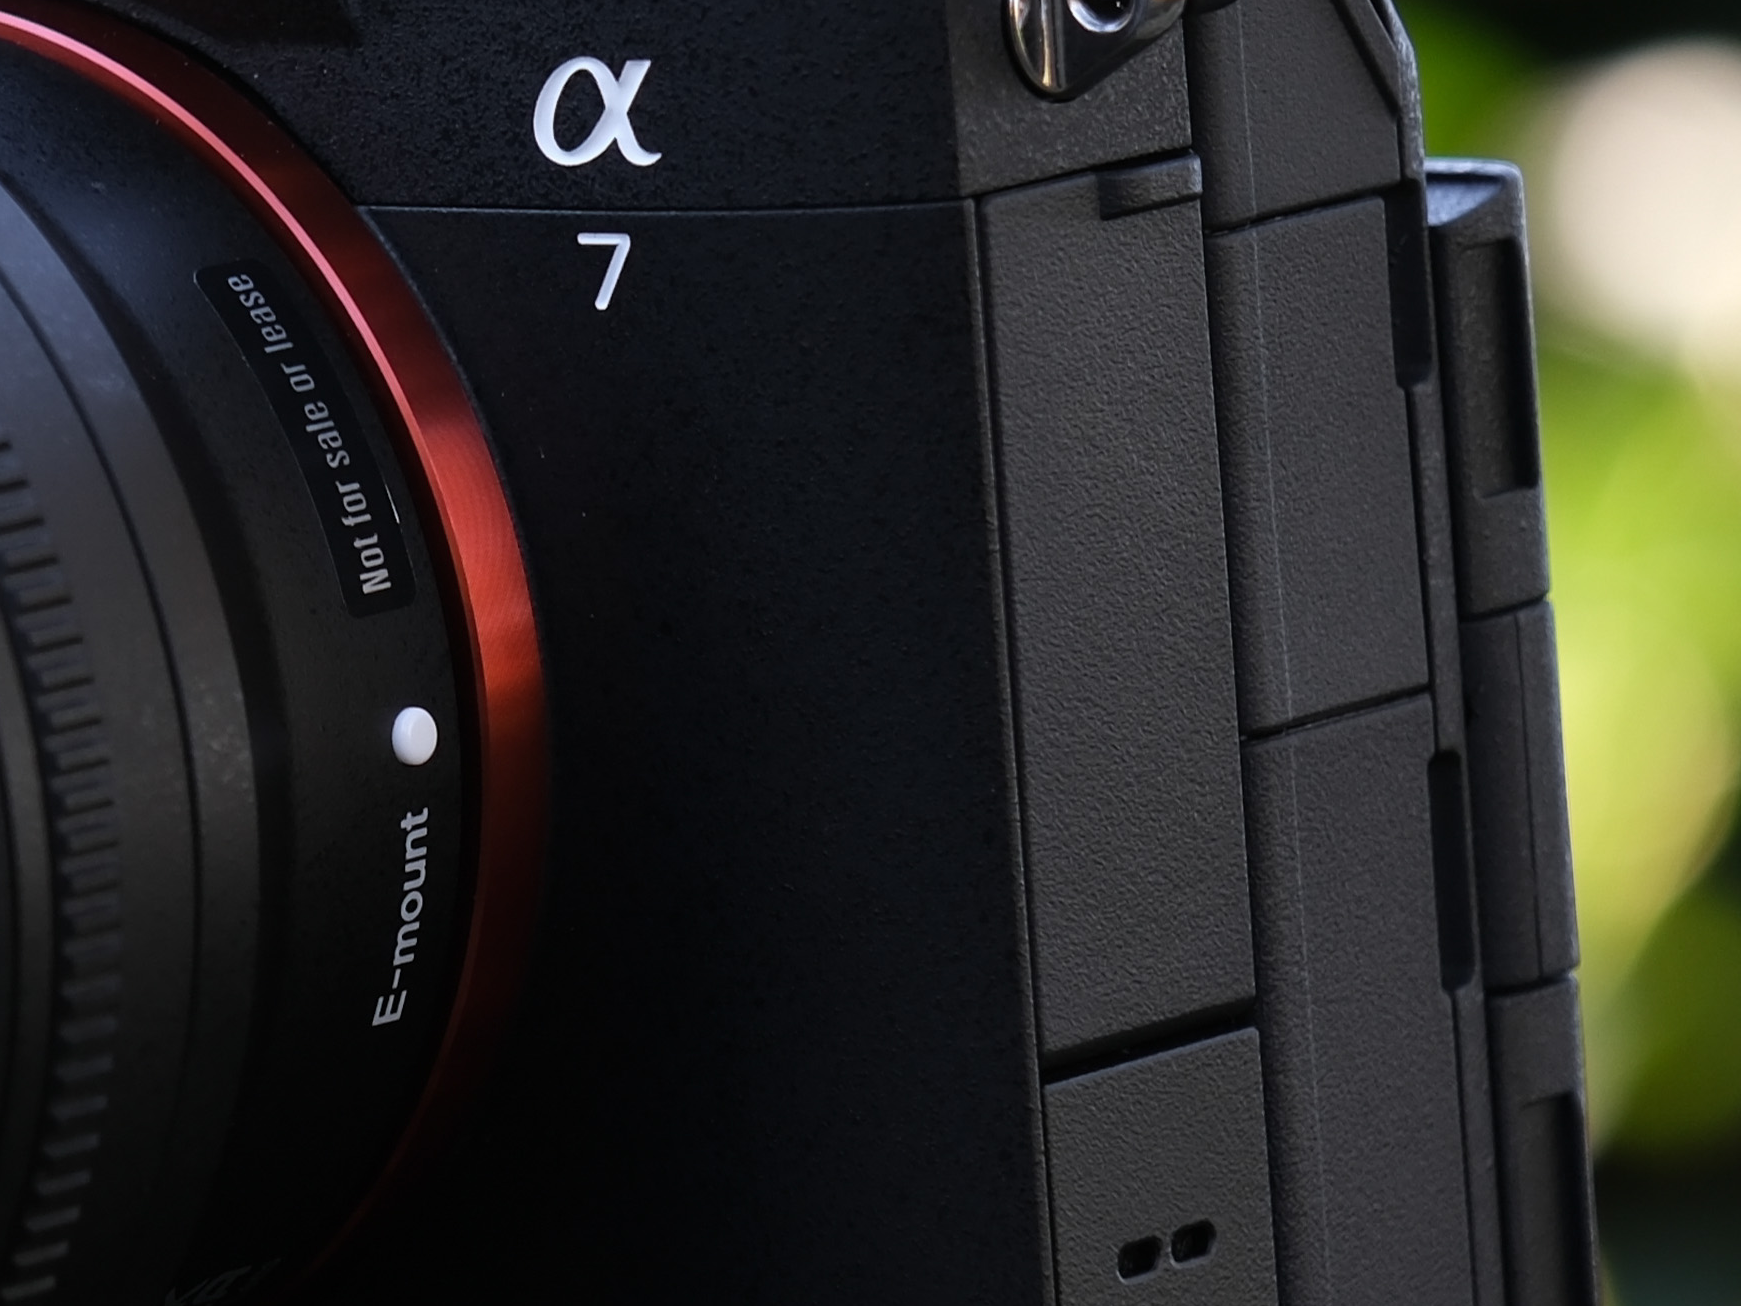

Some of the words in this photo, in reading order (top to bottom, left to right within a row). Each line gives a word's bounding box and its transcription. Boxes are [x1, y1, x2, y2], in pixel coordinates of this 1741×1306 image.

[577, 232, 631, 311] 7
[227, 273, 294, 353] lease
[281, 362, 315, 394] or
[304, 400, 350, 469] sale
[335, 481, 372, 528] for
[353, 533, 392, 595] Not
[372, 807, 429, 1026] E-mount
